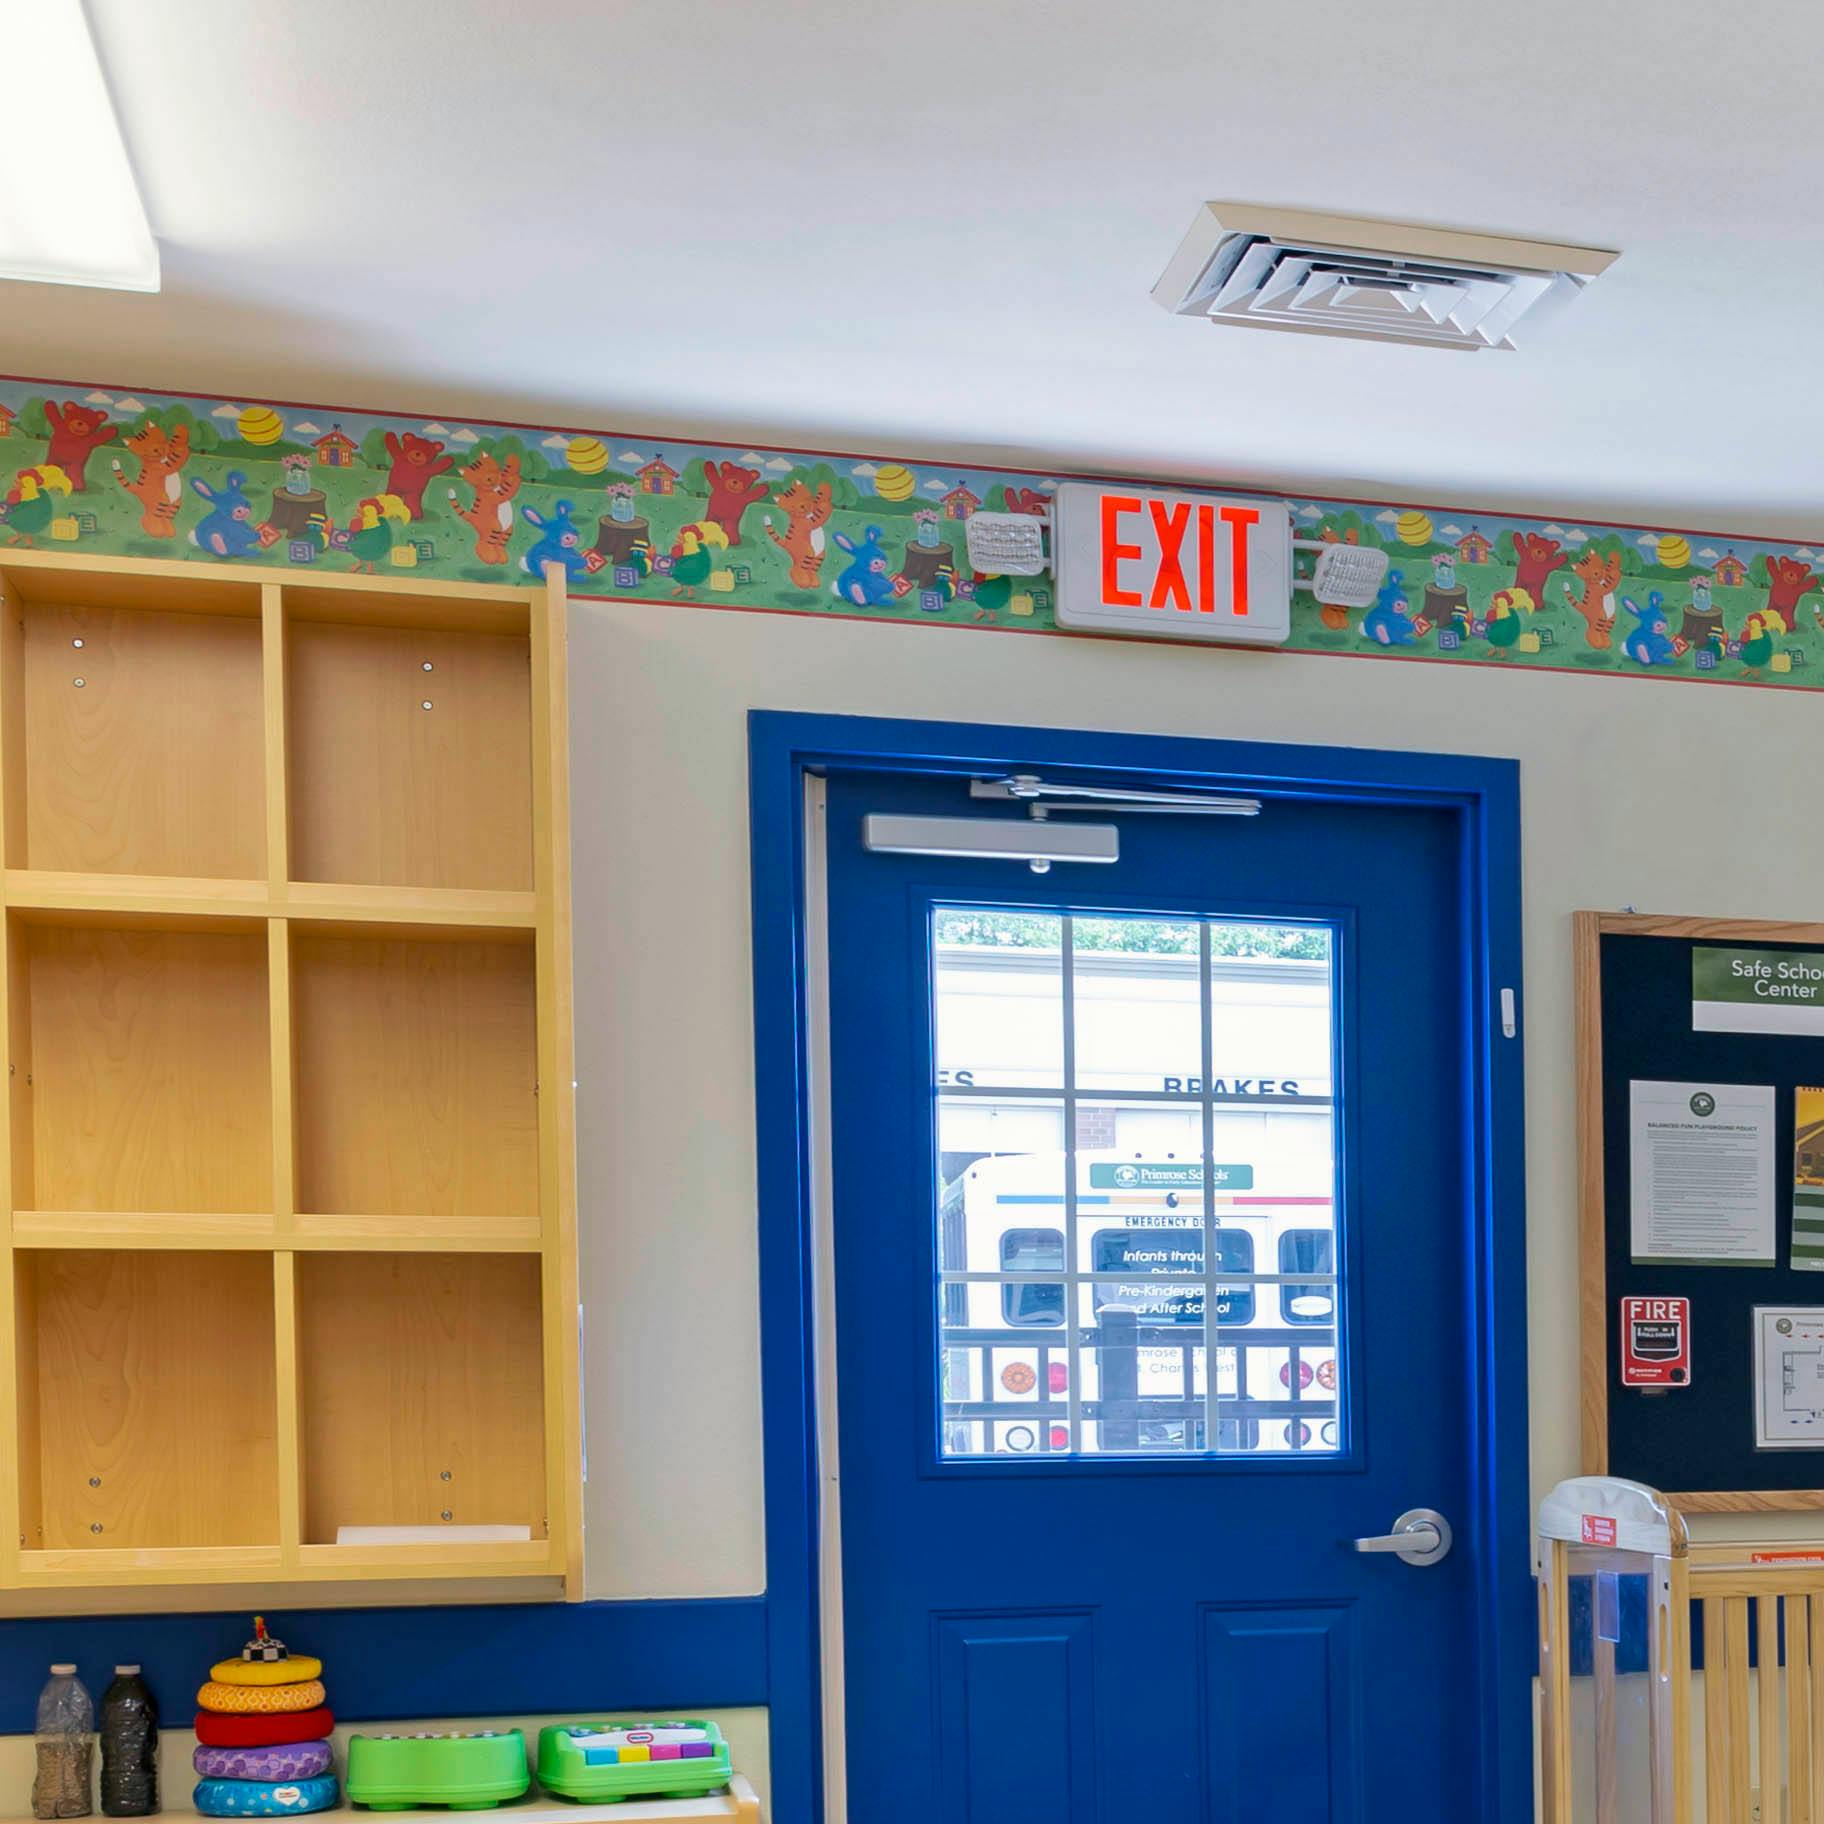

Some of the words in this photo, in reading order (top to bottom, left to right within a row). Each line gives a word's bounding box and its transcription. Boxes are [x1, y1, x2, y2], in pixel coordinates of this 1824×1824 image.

[1099, 494, 1261, 617] EXIT
[1731, 960, 1771, 978] Safe
[1754, 979, 1818, 999] Center
[1141, 1167, 1186, 1180] Primrose
[1125, 1216, 1187, 1227] EMERGENCY
[1123, 1251, 1167, 1262] Infants
[1150, 1303, 1182, 1313] After
[1630, 1301, 1682, 1320] FIRE
